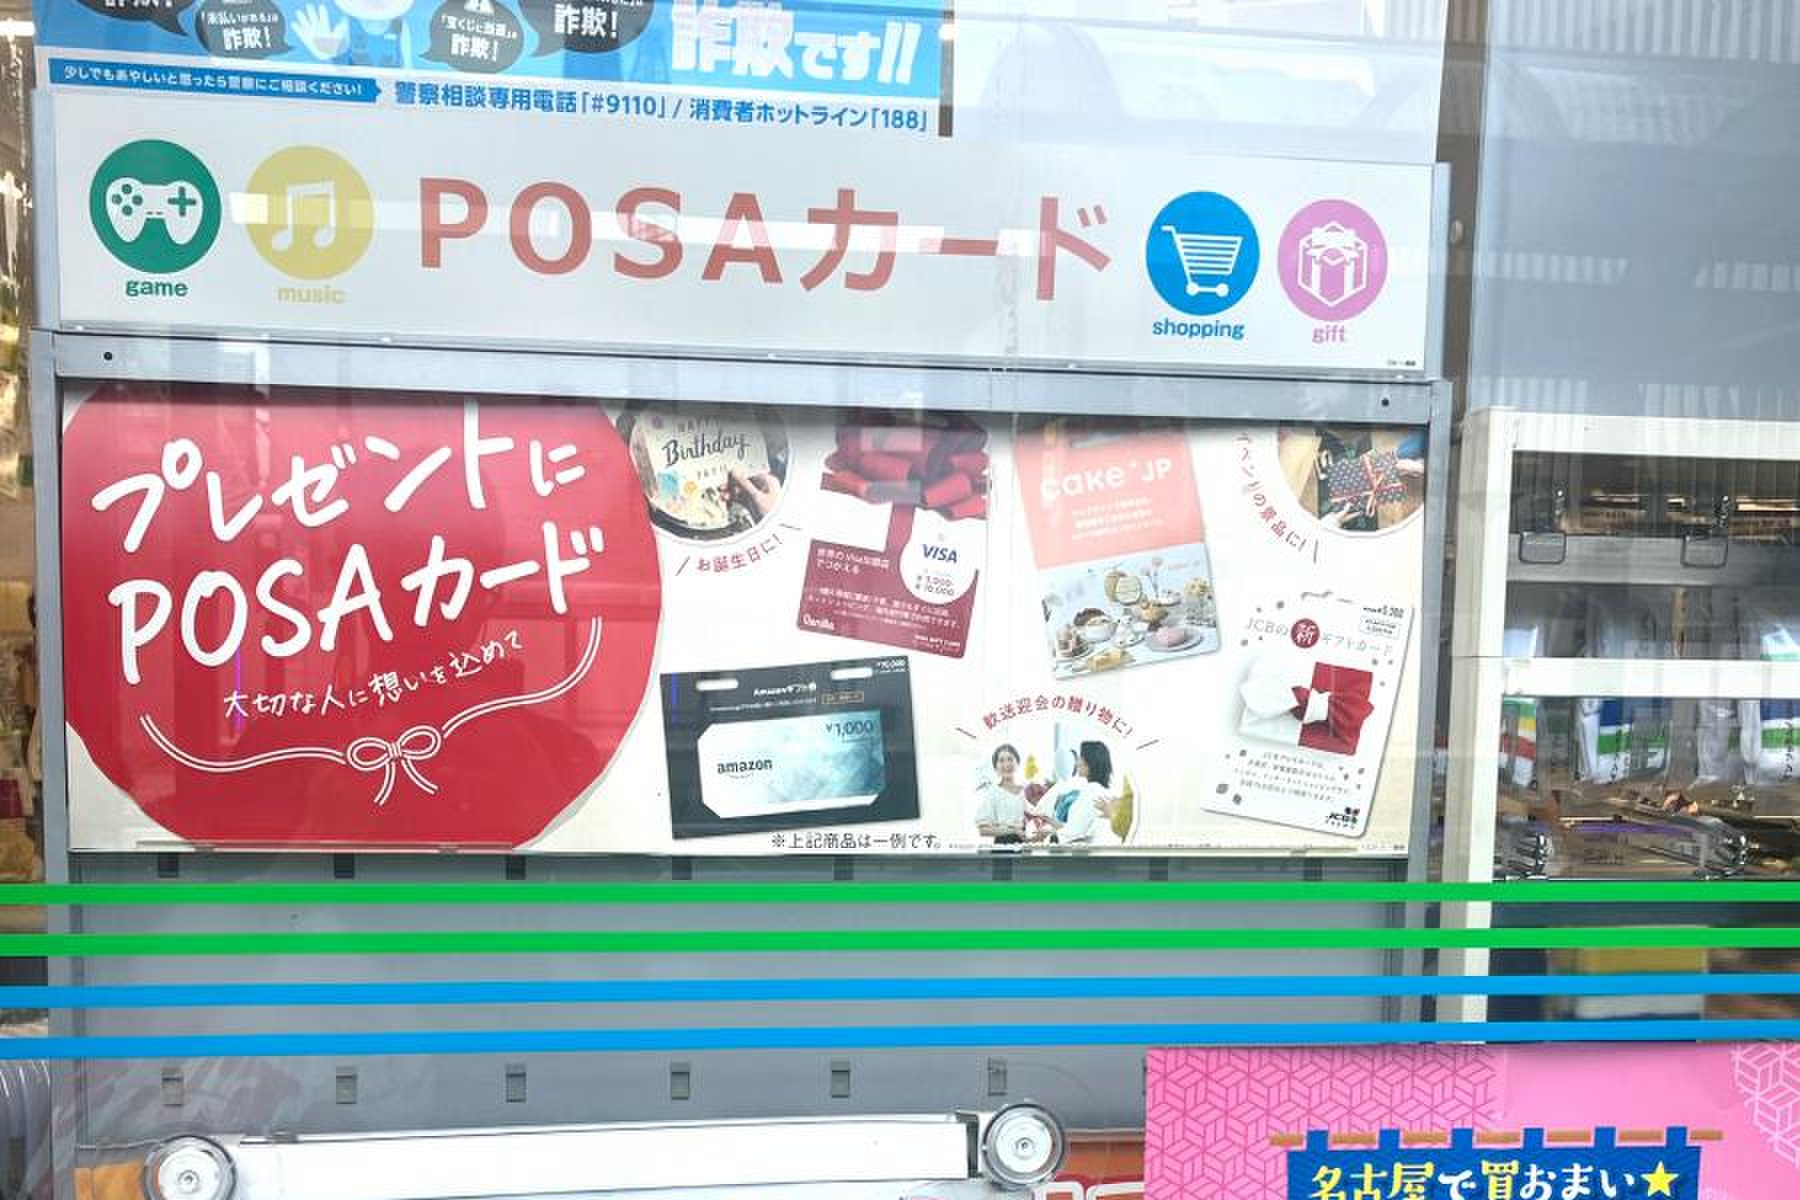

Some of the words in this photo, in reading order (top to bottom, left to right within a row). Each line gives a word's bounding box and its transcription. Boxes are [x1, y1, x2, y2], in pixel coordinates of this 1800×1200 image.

[554, 5, 618, 39] 詐欺!
[418, 177, 1112, 303] POSAカード
[125, 279, 189, 298] game
[276, 284, 345, 305] music
[1152, 319, 1246, 342] shopping
[1312, 320, 1348, 345] gift
[661, 431, 751, 467] Birthday
[91, 400, 587, 554] プレゼントに
[922, 543, 959, 564] VISA
[108, 520, 605, 685] POSAカード
[223, 629, 524, 719] 大切な人に想いを込めて
[717, 757, 773, 776] amazon
